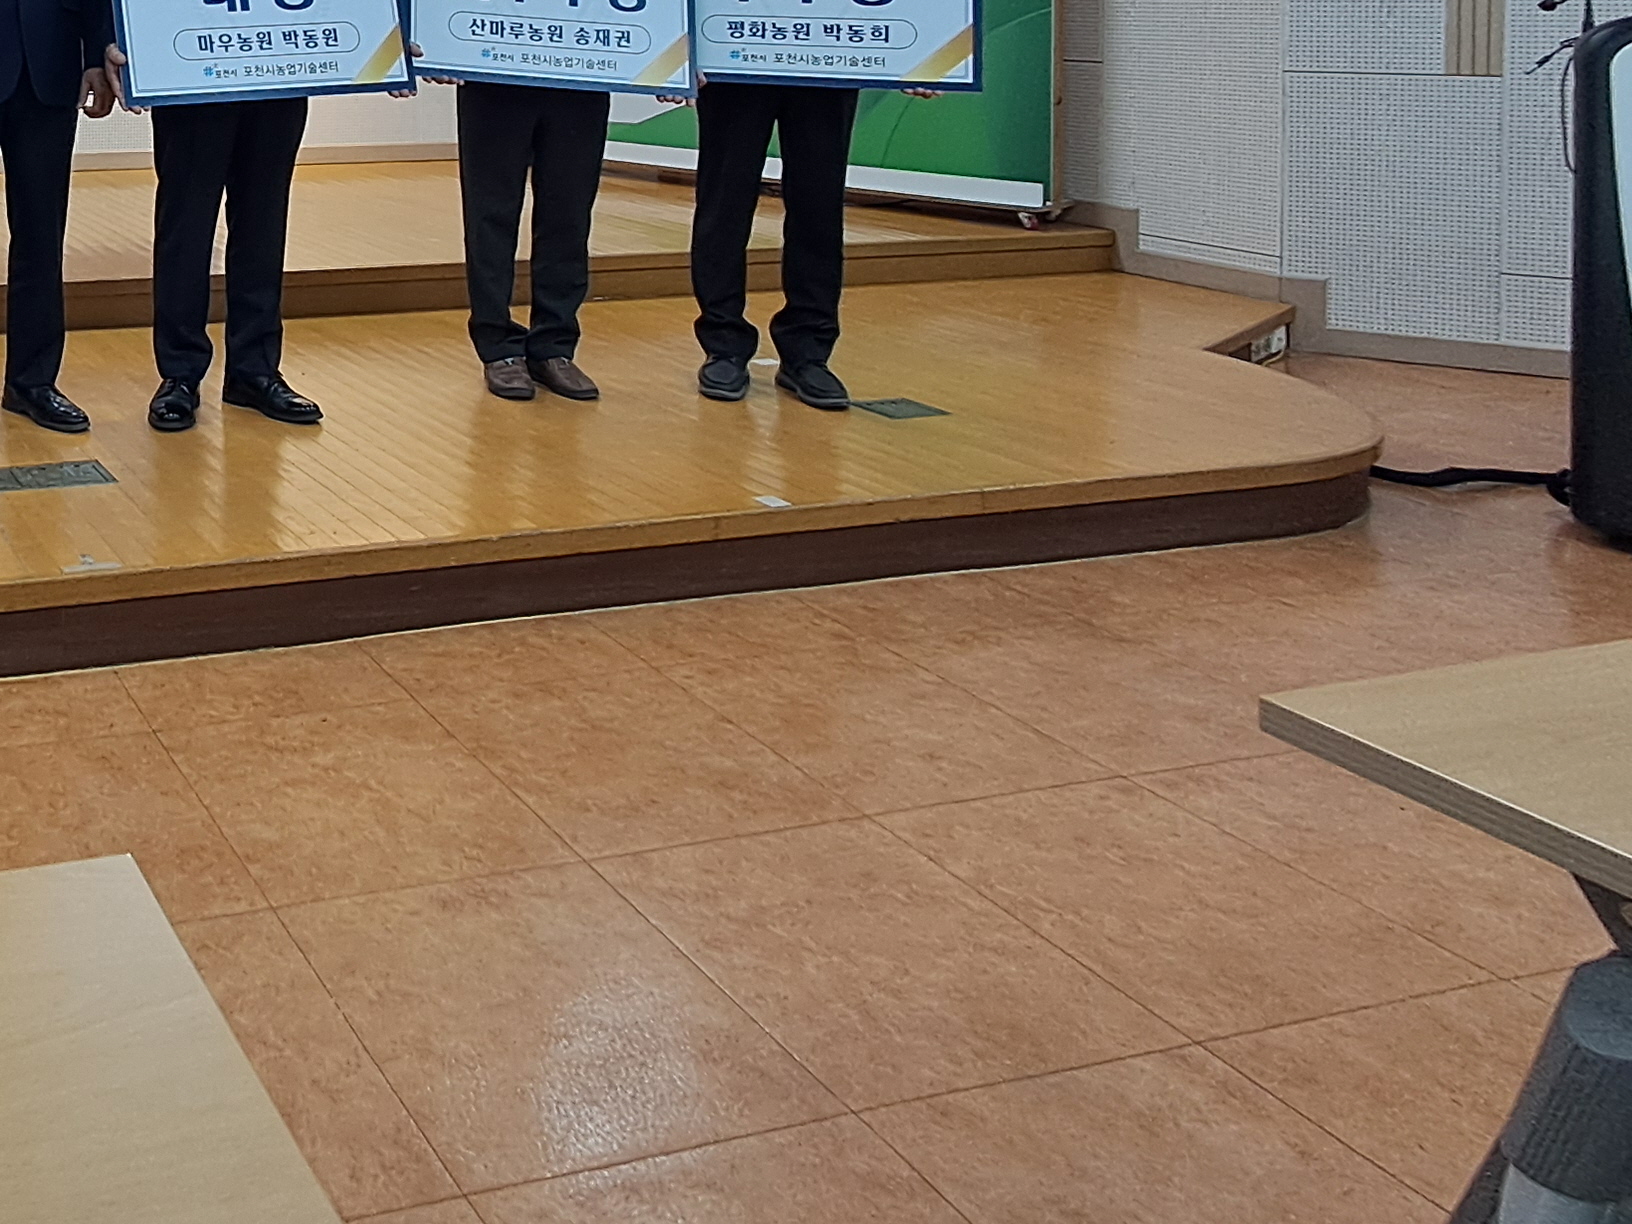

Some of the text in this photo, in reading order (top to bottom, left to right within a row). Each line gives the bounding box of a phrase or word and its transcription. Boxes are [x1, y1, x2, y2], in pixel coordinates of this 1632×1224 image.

[197, 27, 339, 54] 마우농원 박동원
[468, 17, 631, 48] 산마루농원 송재권
[726, 20, 890, 43] 평화농원 박동희
[243, 61, 339, 77] 포천시농업기술센터
[520, 53, 617, 71] 포천시농업기술센터
[773, 53, 886, 68] 포천시농업기술센터
